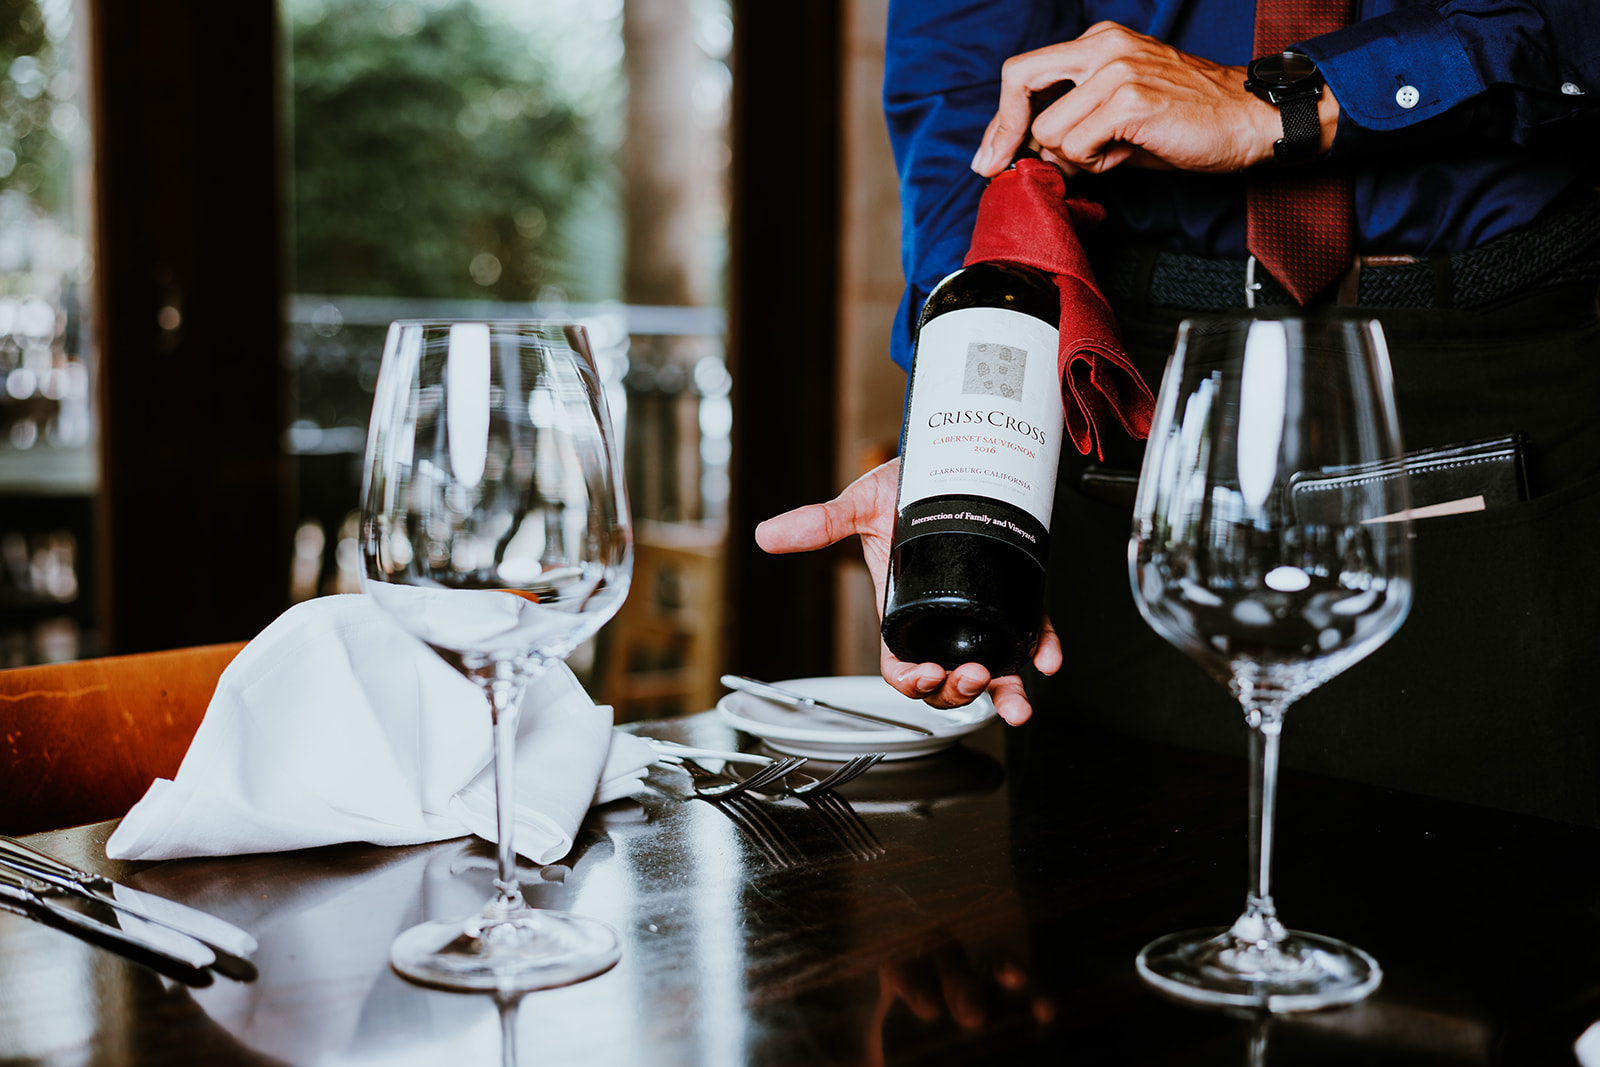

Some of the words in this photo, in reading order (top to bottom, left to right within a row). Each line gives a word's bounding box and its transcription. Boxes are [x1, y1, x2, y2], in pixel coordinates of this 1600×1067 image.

[928, 410, 984, 428] CRISS
[987, 410, 1047, 446] CROSS
[933, 435, 982, 446] CABERNET
[983, 436, 1036, 459] SAUVIGNON
[974, 445, 997, 455] 2016
[929, 467, 982, 477] CLARKSBURG
[984, 469, 1032, 491] CALIFORNIA
[911, 512, 953, 526] Intersection
[954, 511, 965, 520] of
[965, 512, 992, 525] Family
[992, 519, 1007, 528] and
[1007, 521, 1037, 544] Vineyards
